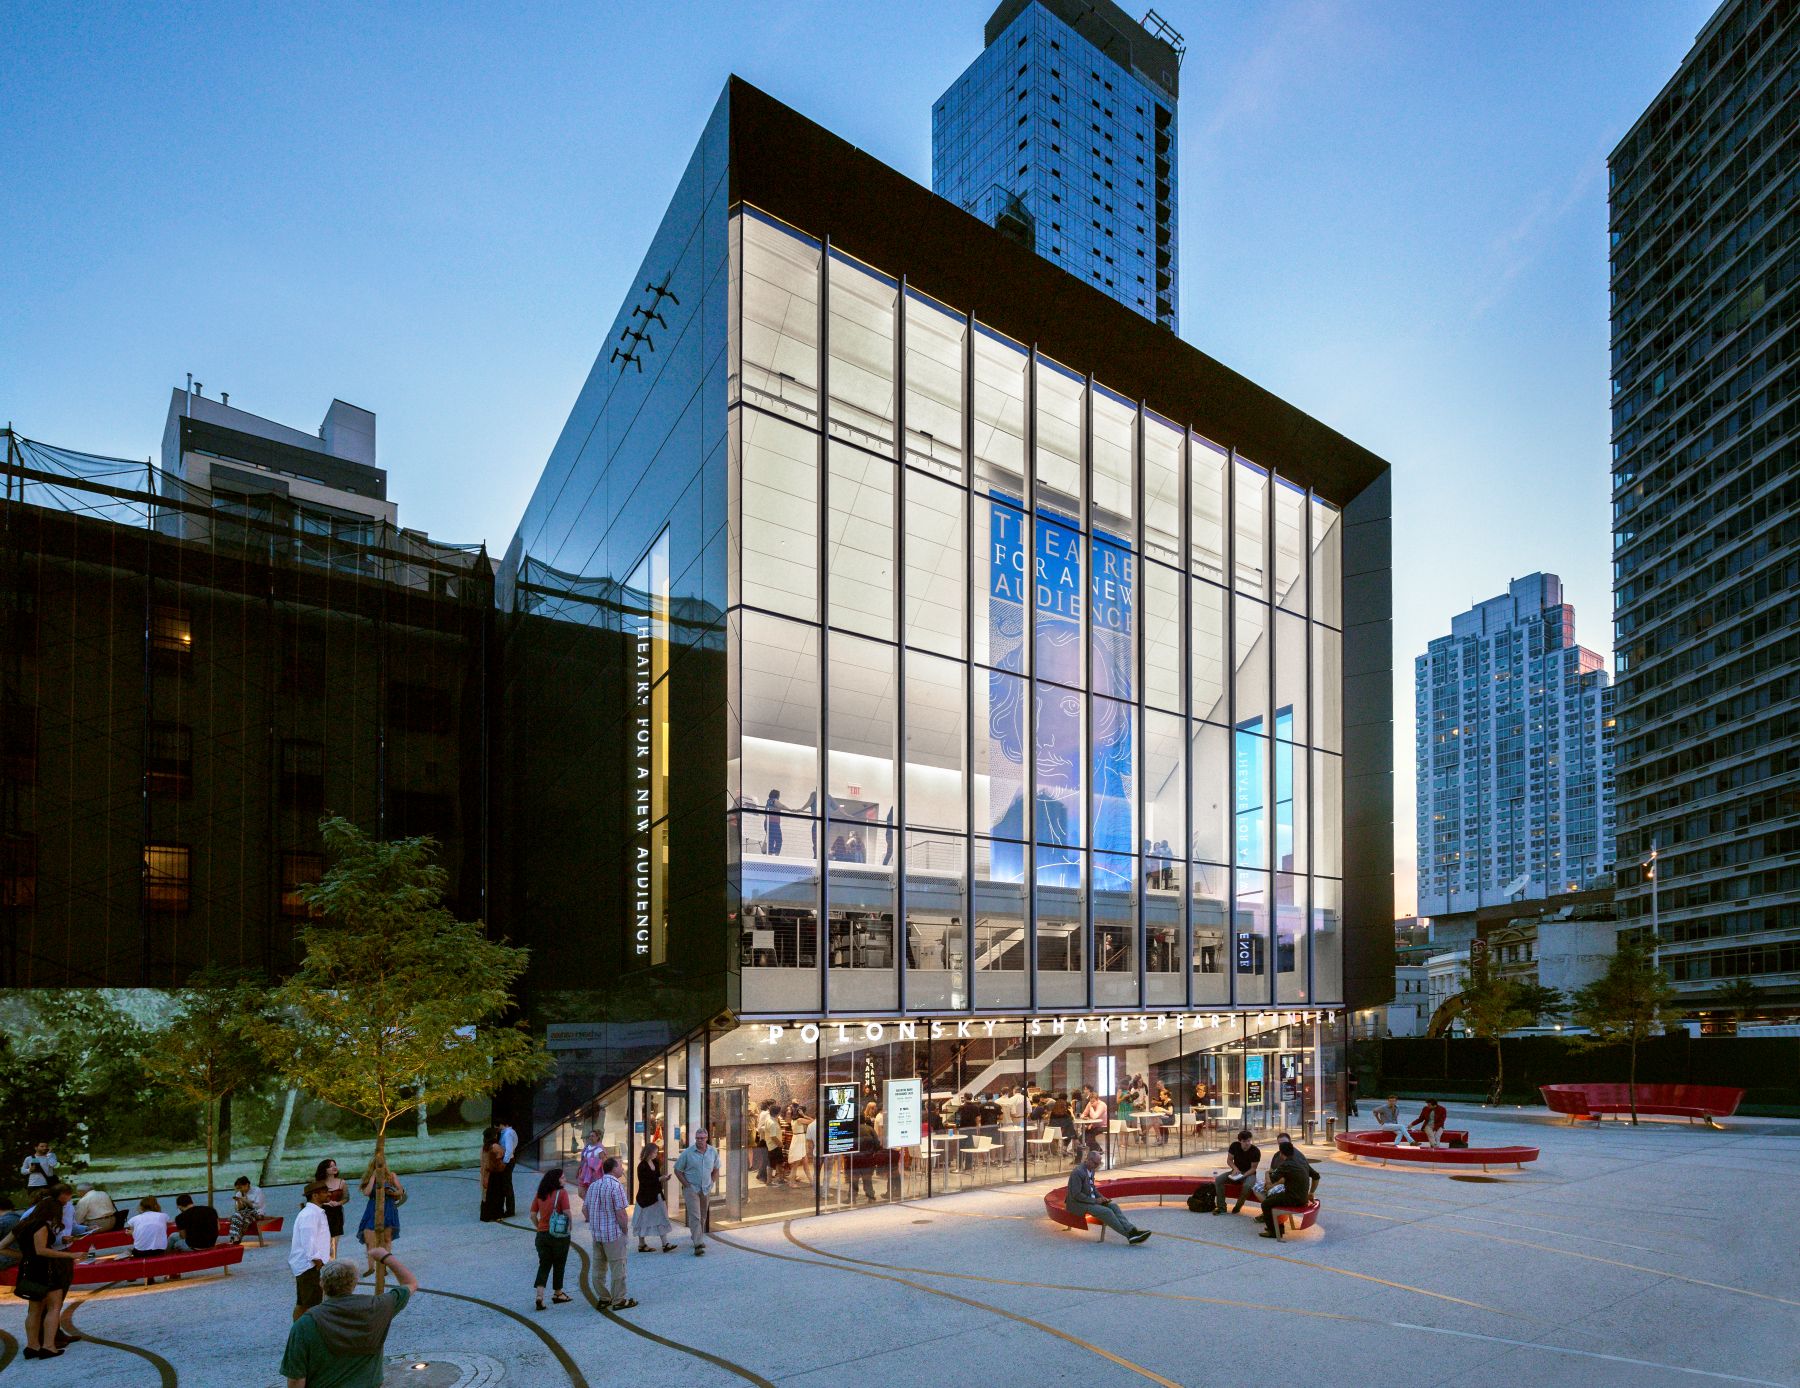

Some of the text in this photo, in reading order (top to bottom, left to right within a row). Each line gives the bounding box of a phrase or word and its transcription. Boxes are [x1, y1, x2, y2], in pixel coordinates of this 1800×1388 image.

[994, 510, 1132, 582] TEARE
[995, 543, 1132, 606] FOR A NEW
[637, 616, 649, 955] THEATRE FOR A NEW AUDIENCE
[769, 1010, 1336, 1044] POLONSKY SHAKESPEARE CENTER
